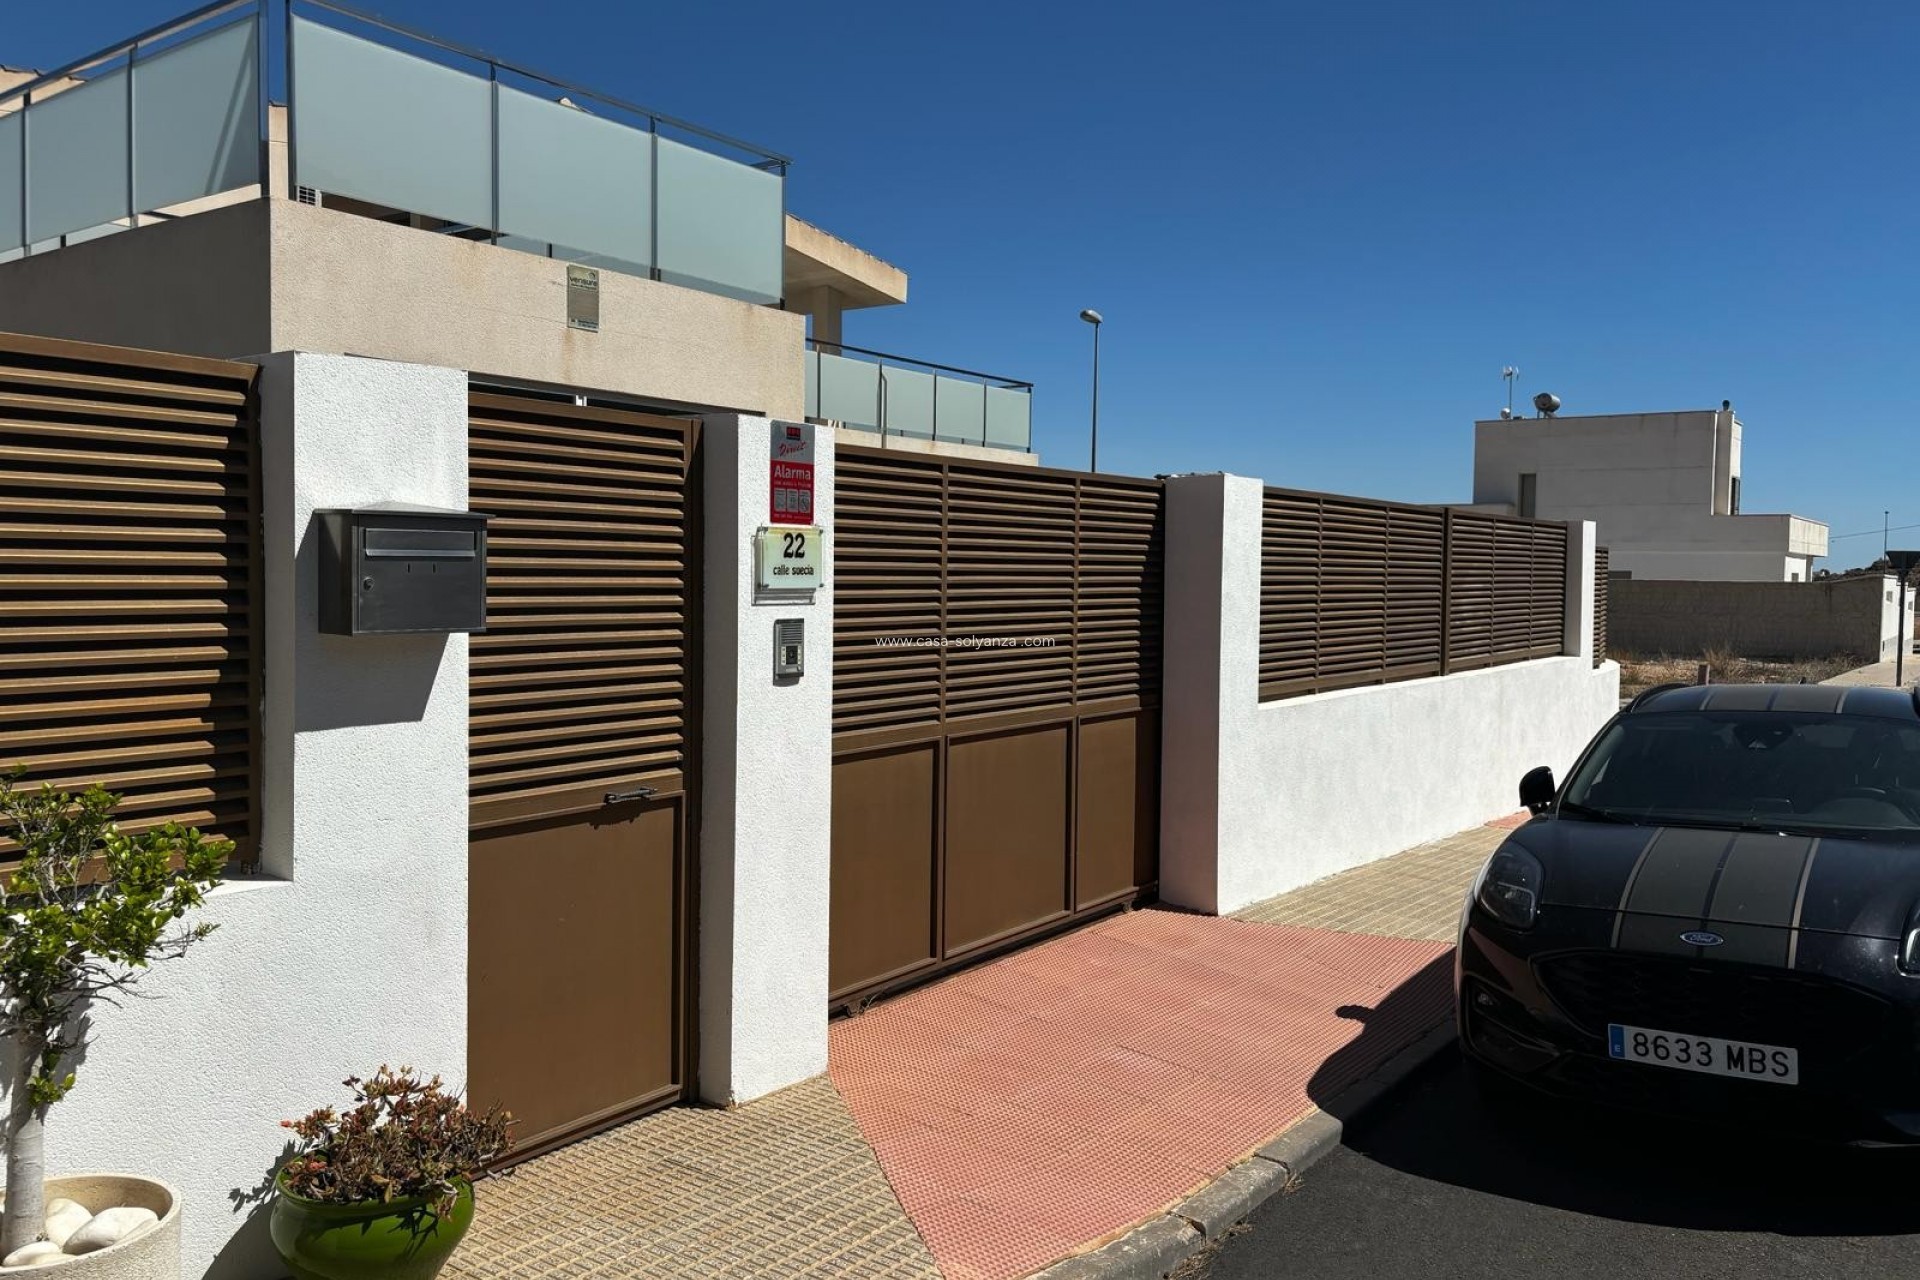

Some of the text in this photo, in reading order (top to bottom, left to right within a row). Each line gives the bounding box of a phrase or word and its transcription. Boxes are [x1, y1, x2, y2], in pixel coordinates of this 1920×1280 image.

[774, 464, 811, 480] Alarma
[783, 532, 805, 558] 22
[773, 564, 790, 576] calle
[1614, 1032, 1789, 1077] E 8633 MBS
